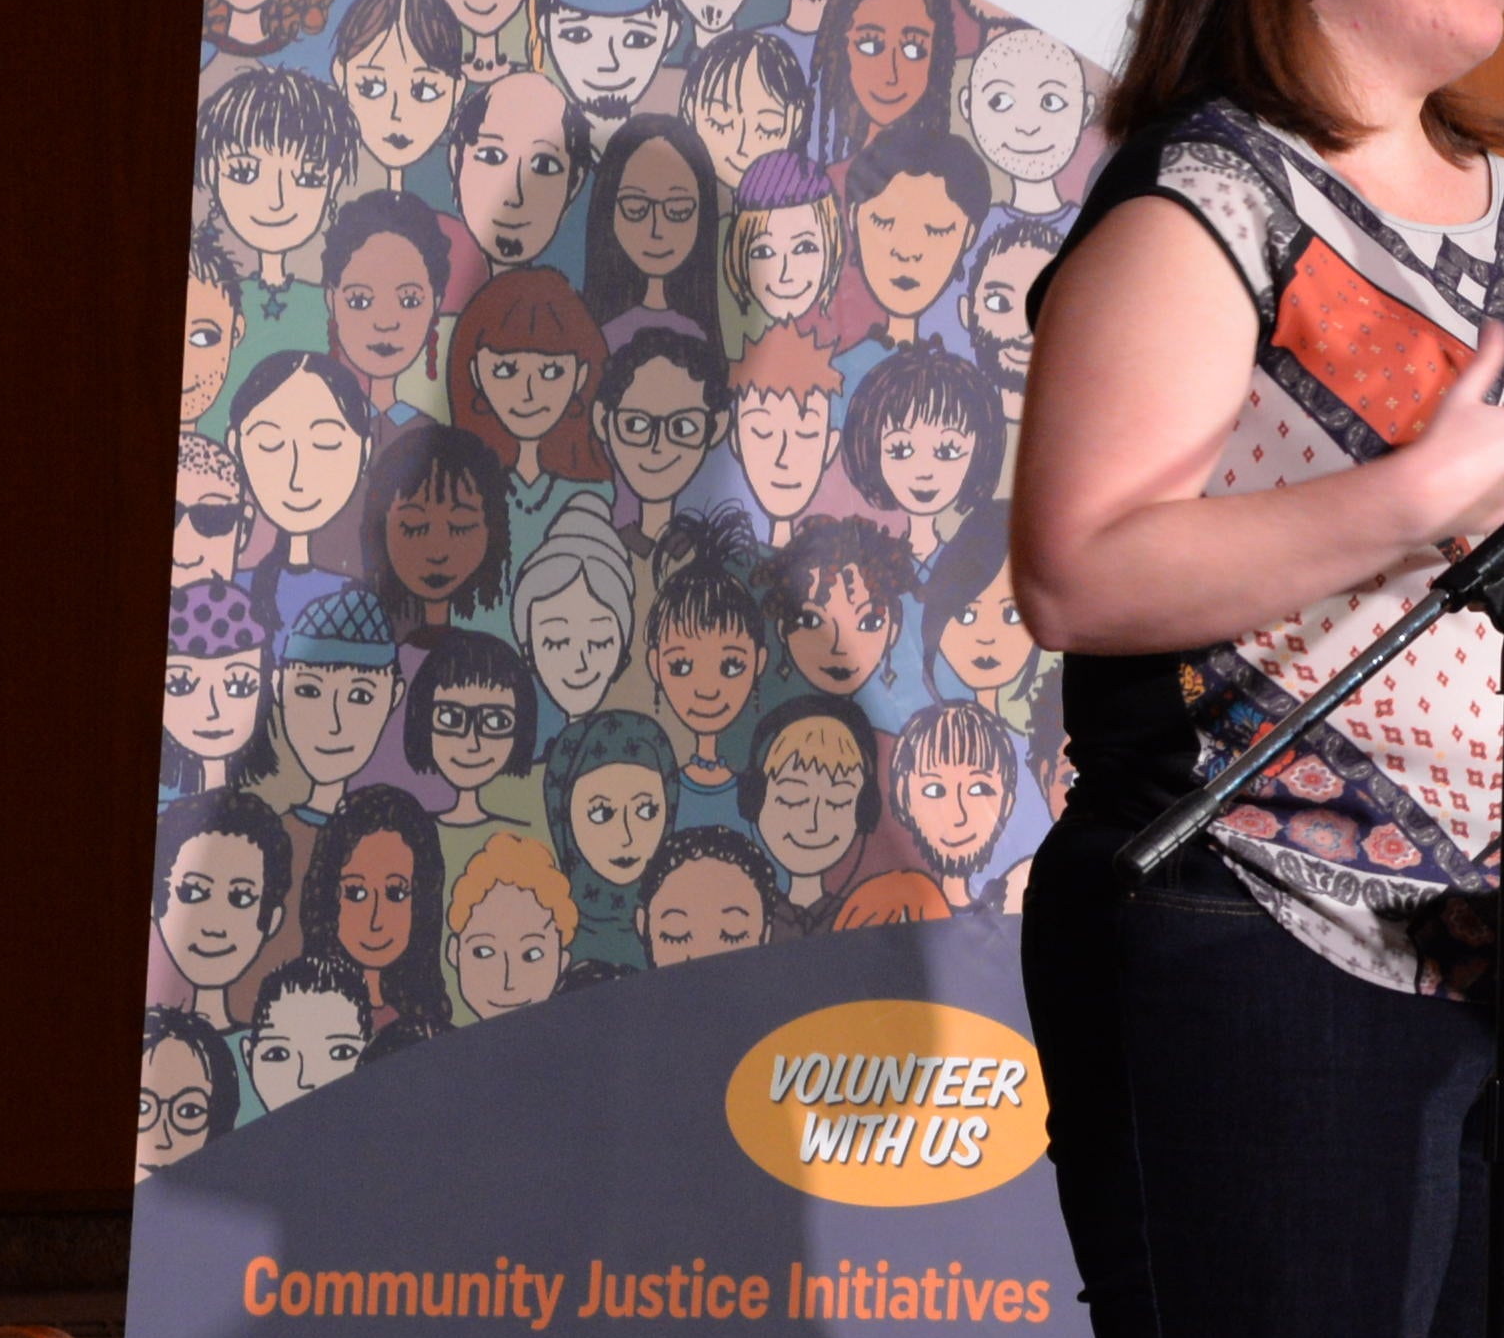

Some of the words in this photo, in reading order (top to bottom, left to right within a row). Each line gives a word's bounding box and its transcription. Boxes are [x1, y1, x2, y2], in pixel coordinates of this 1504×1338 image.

[769, 1052, 1027, 1108] VOLUNTEER
[799, 1111, 916, 1166] WITH
[919, 1115, 989, 1168] US
[244, 1256, 565, 1331] Community
[578, 1257, 770, 1319] Justice
[788, 1258, 1051, 1323] Initiatives
